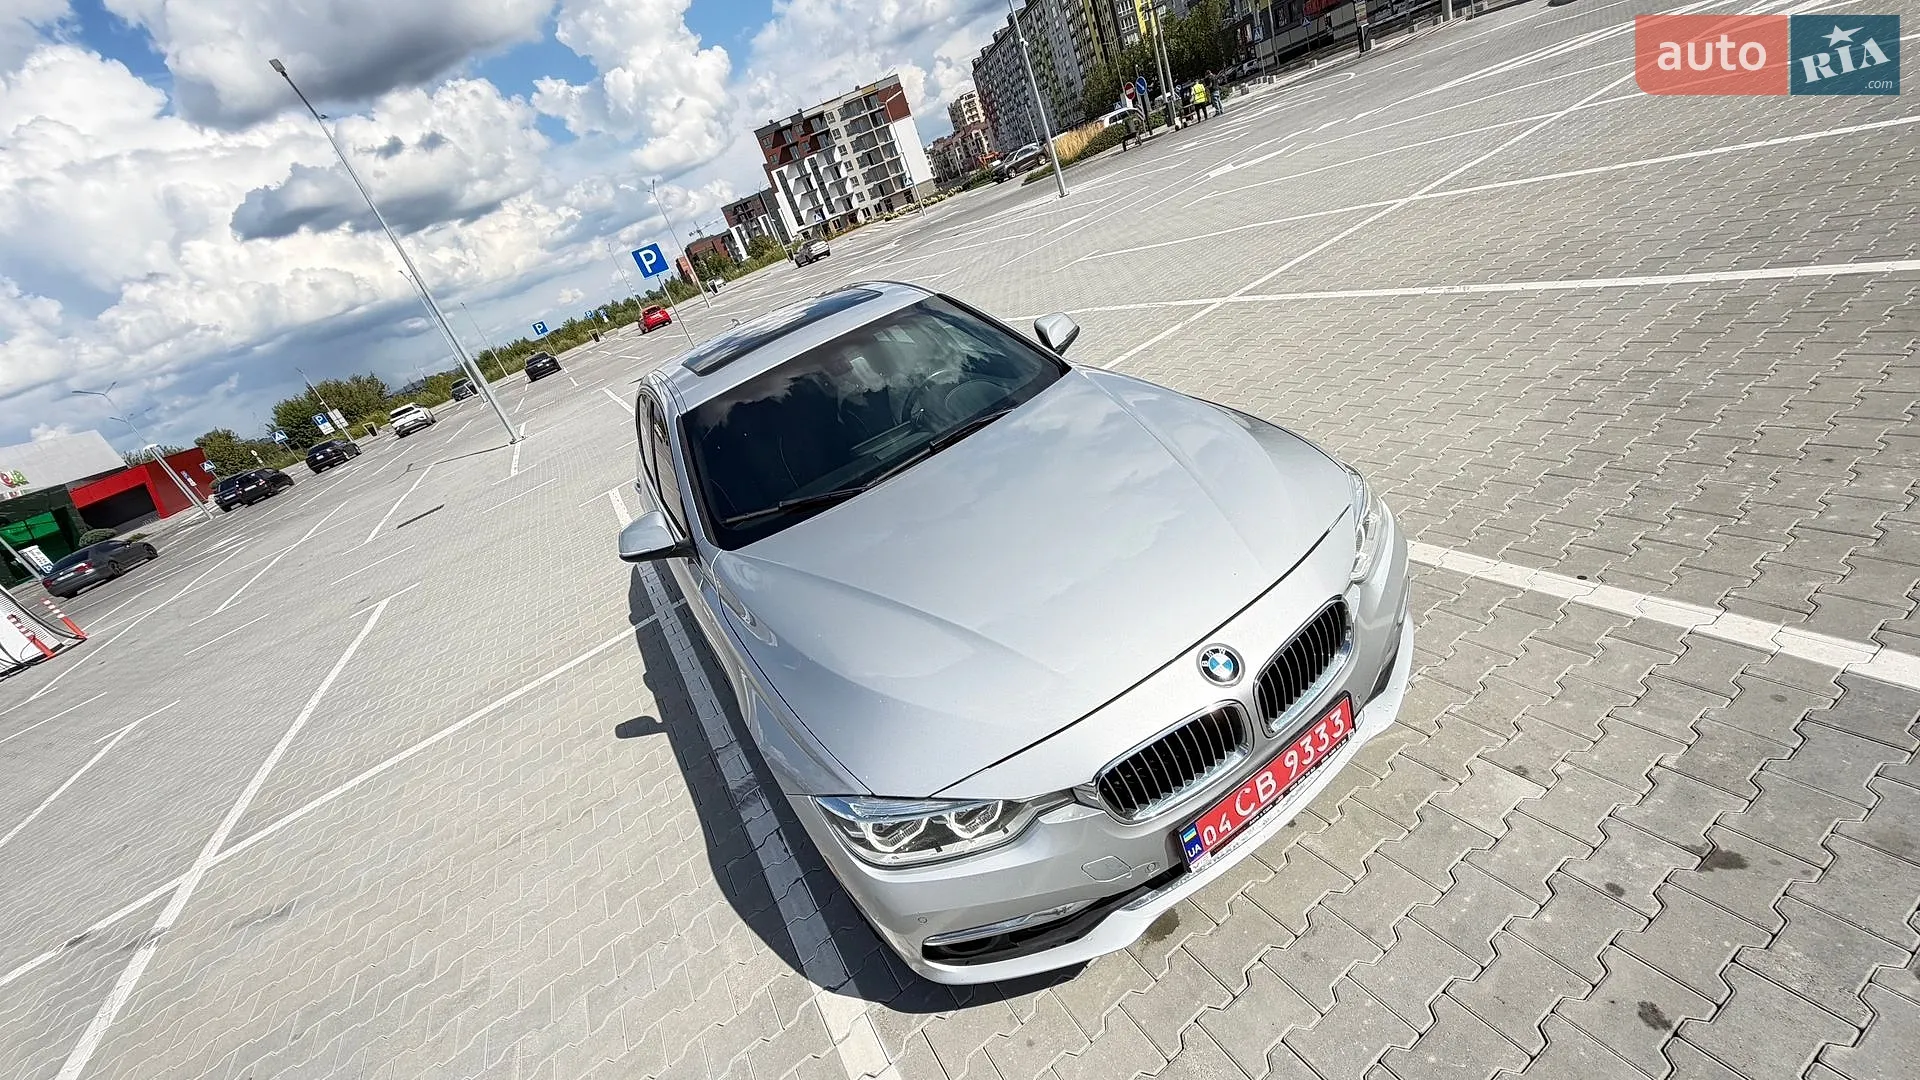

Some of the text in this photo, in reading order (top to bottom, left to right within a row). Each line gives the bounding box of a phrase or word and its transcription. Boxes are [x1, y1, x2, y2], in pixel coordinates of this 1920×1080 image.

[639, 249, 657, 274] P
[536, 323, 544, 334] P
[315, 415, 323, 424] P
[1202, 648, 1226, 667] BMW
[1202, 813, 1231, 846] 04
[1234, 770, 1277, 816] CB
[1283, 707, 1345, 780] 9333
[1187, 844, 1202, 859] UA
